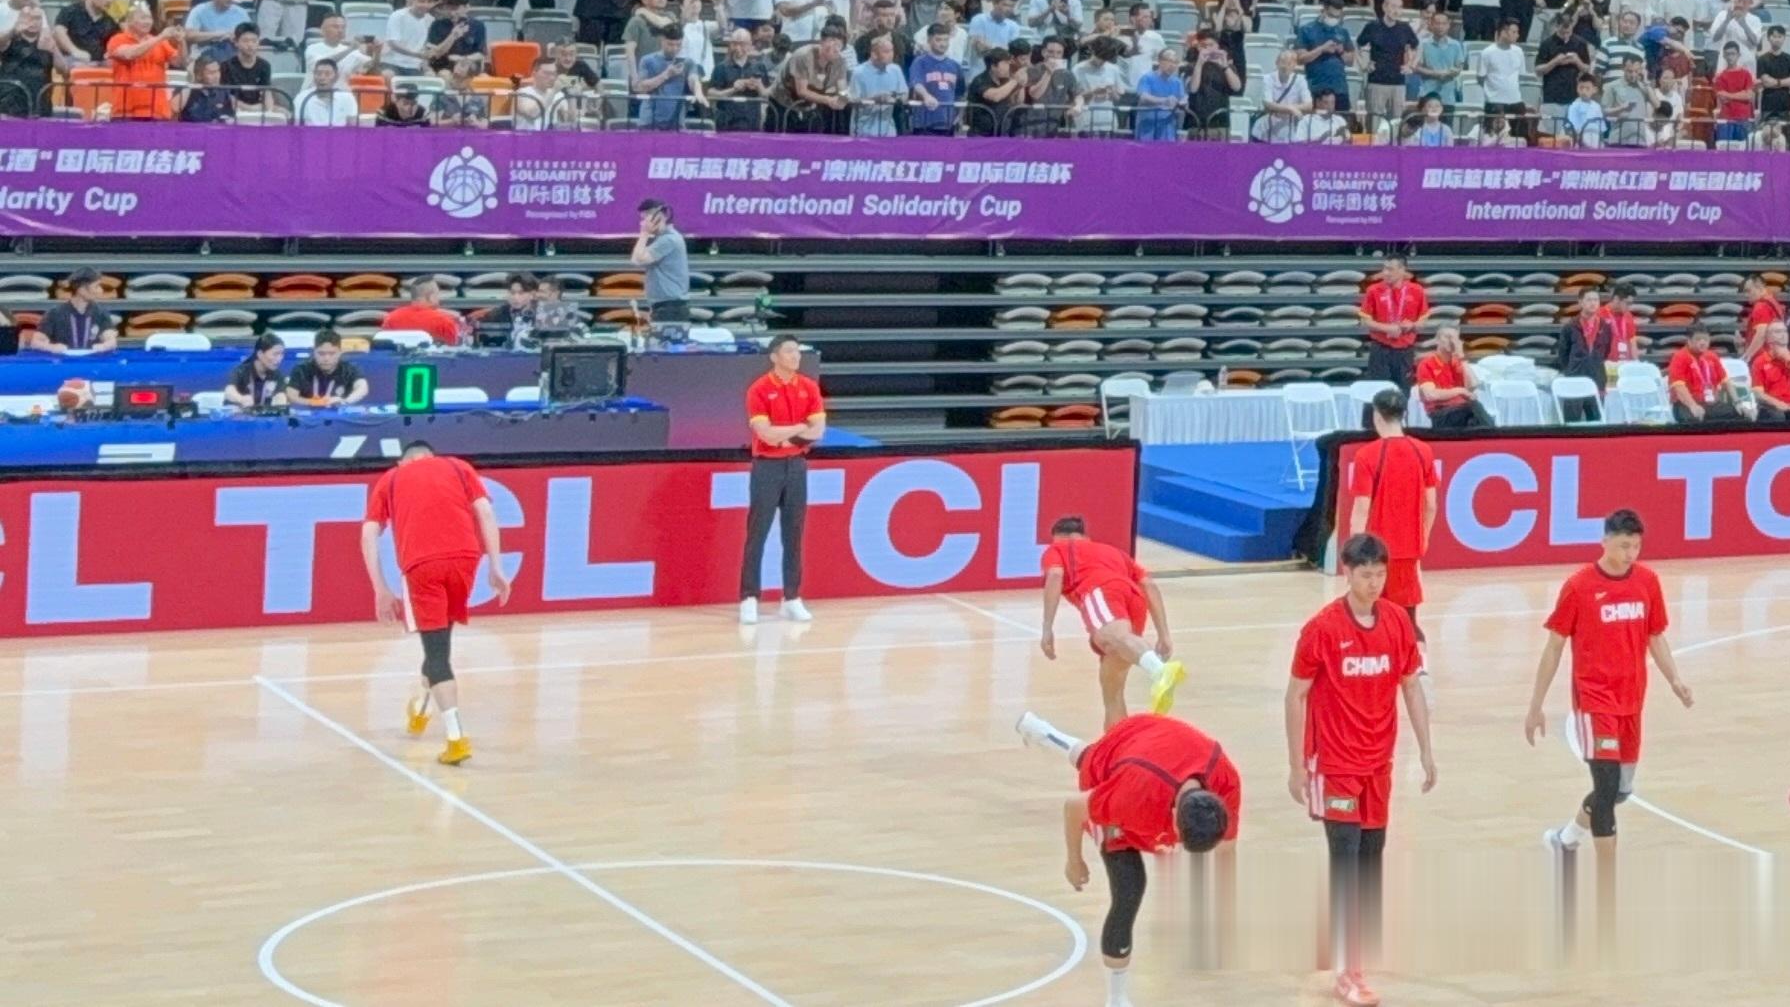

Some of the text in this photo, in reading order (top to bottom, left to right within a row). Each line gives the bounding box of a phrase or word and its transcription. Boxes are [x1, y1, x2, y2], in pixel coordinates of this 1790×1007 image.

[509, 170, 617, 183] SOLIDARITY CUP
[1313, 180, 1399, 192] SOLIDARITY CUP
[84, 186, 138, 216] Cup
[508, 184, 615, 205] 国际团结杯
[704, 192, 1022, 221] International Solidarity Cup
[1465, 200, 1722, 225] International Solidarity Cup
[405, 367, 430, 410] 0
[1348, 452, 1606, 553] CL
[0, 489, 152, 625] L
[1600, 600, 1646, 624] CHINA
[1342, 653, 1391, 678] CHINA
